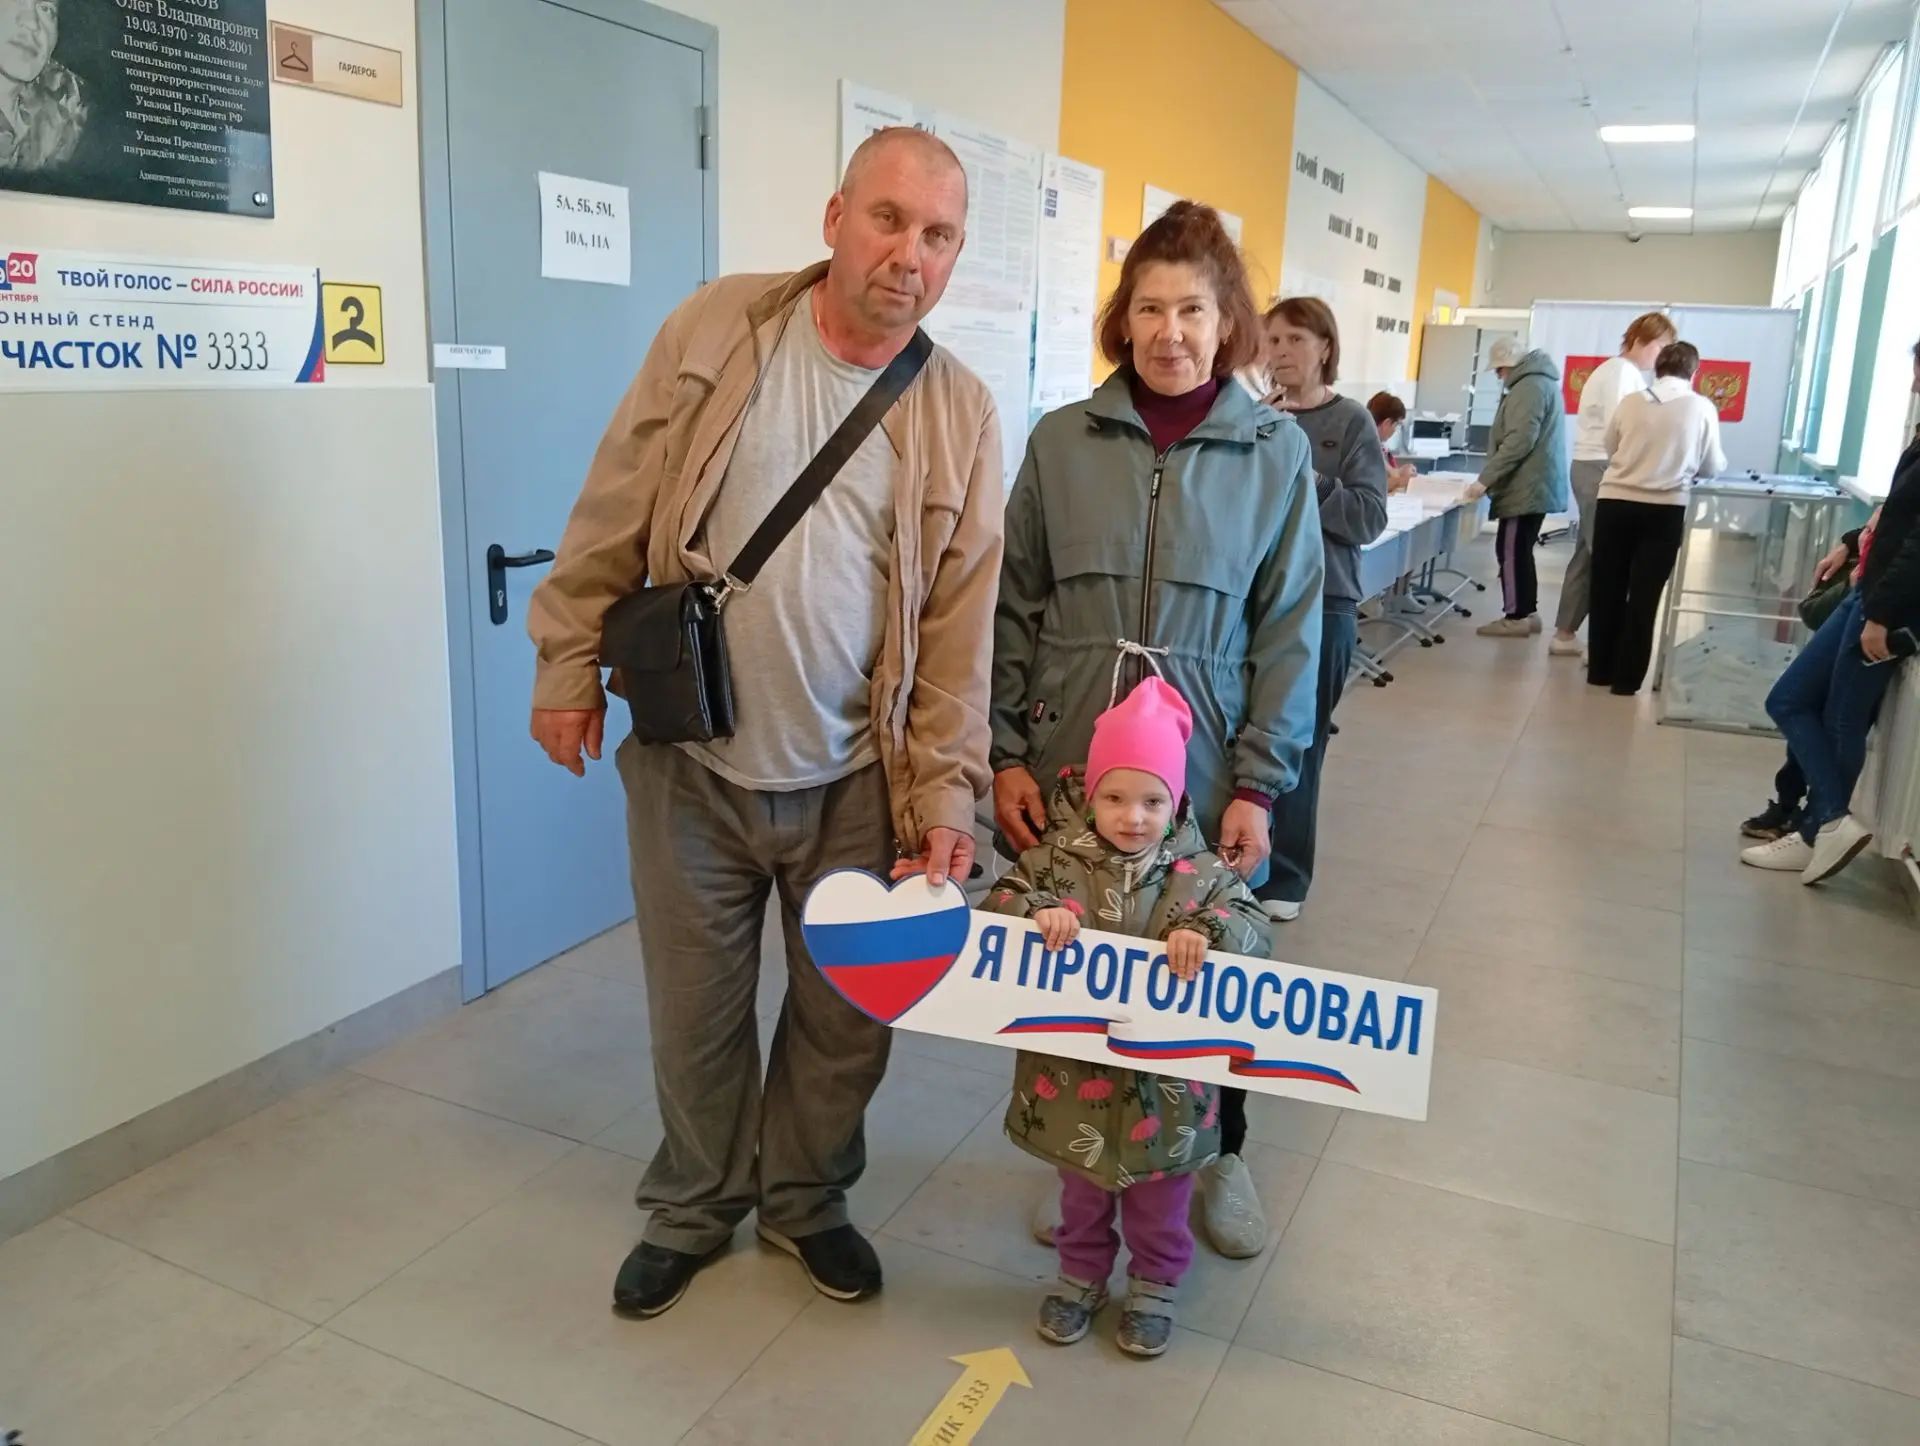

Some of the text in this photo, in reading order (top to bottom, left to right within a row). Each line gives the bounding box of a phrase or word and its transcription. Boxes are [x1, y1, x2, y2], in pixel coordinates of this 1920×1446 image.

[157, 0, 259, 40] Владимирович
[125, 15, 188, 41] 19.03.1970
[198, 32, 253, 56] 26.08.2001
[123, 34, 248, 71] Погиб при выполнении
[111, 49, 188, 73] специального
[190, 66, 232, 82] задания
[243, 77, 264, 88] ходе
[126, 67, 249, 98] контртеррористической
[338, 61, 377, 78] ГАРДЕРОБ
[130, 82, 182, 100] операции
[185, 92, 191, 101] в
[135, 95, 243, 123] Указом Президента РФ
[179, 119, 217, 133] орденом
[135, 130, 171, 145] Указом
[174, 136, 227, 153] Президента
[556, 194, 574, 212] 5А,
[577, 197, 594, 215] 5Б,
[565, 230, 610, 250] 10А, 11А
[9, 260, 34, 278] 20
[57, 268, 109, 288] ТВОЙ
[114, 273, 172, 291] ГОЛОС
[191, 277, 234, 294] СИЛА
[238, 280, 303, 298] РОССИИ!
[0, 293, 39, 303] НТЯБРЯ
[89, 313, 155, 330] СТЕНД
[1, 331, 269, 371] ЧАСТОК № 3333
[971, 924, 1424, 1056] Я ПРОГОЛОСОВАЛ
[957, 1379, 990, 1415] 3333
